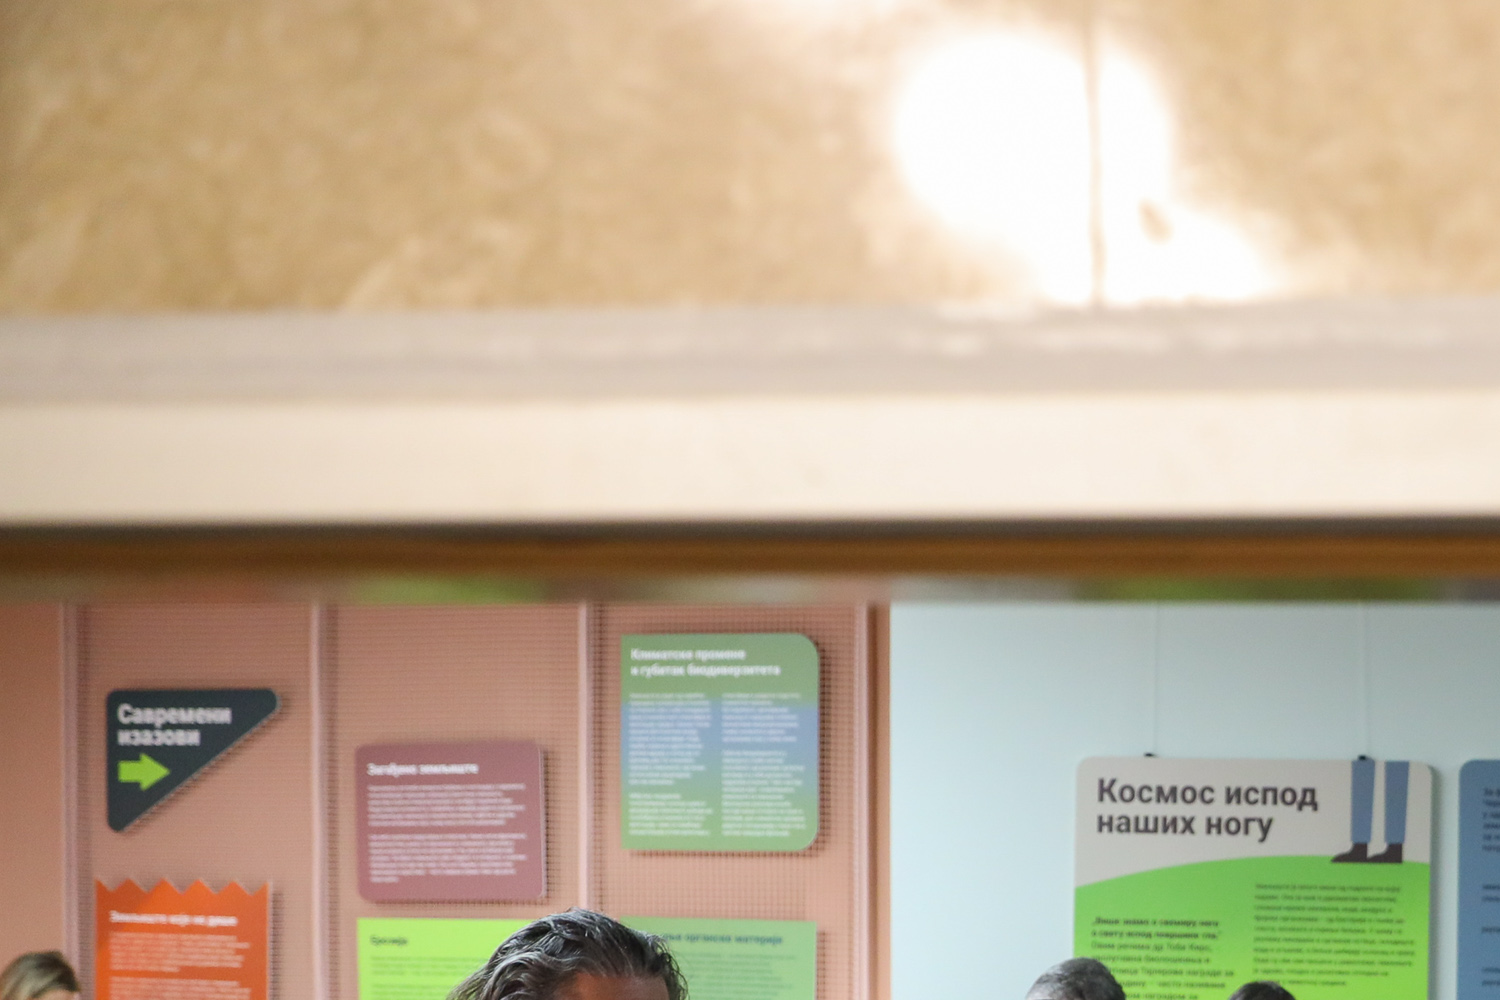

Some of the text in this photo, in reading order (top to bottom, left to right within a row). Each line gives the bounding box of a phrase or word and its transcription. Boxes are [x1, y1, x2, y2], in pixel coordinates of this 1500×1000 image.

[117, 703, 232, 728] Савремени
[117, 729, 200, 746] изазови
[1098, 778, 1319, 812] Космос испод
[1097, 813, 1273, 843] наших ногу
